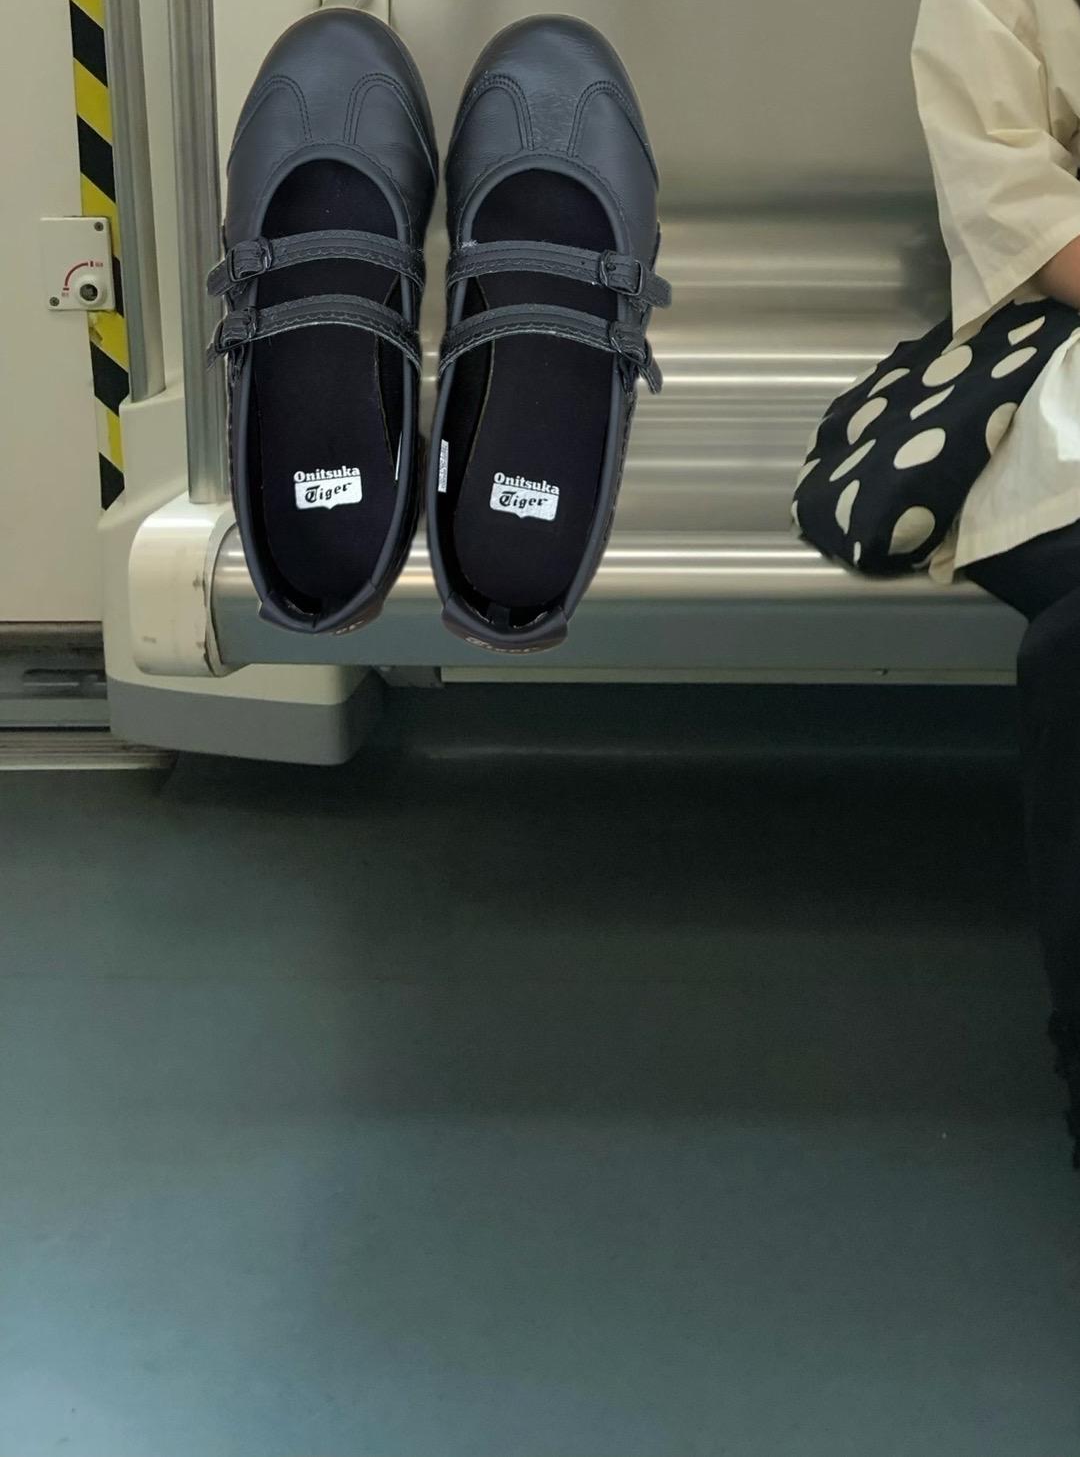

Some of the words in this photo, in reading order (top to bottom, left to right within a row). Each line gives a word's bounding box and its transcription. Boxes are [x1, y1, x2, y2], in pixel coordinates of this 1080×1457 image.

[294, 465, 360, 483] Onitsuka
[494, 472, 559, 495] Onitsuka
[305, 483, 352, 503] Tiger
[499, 491, 548, 509] Tiger
